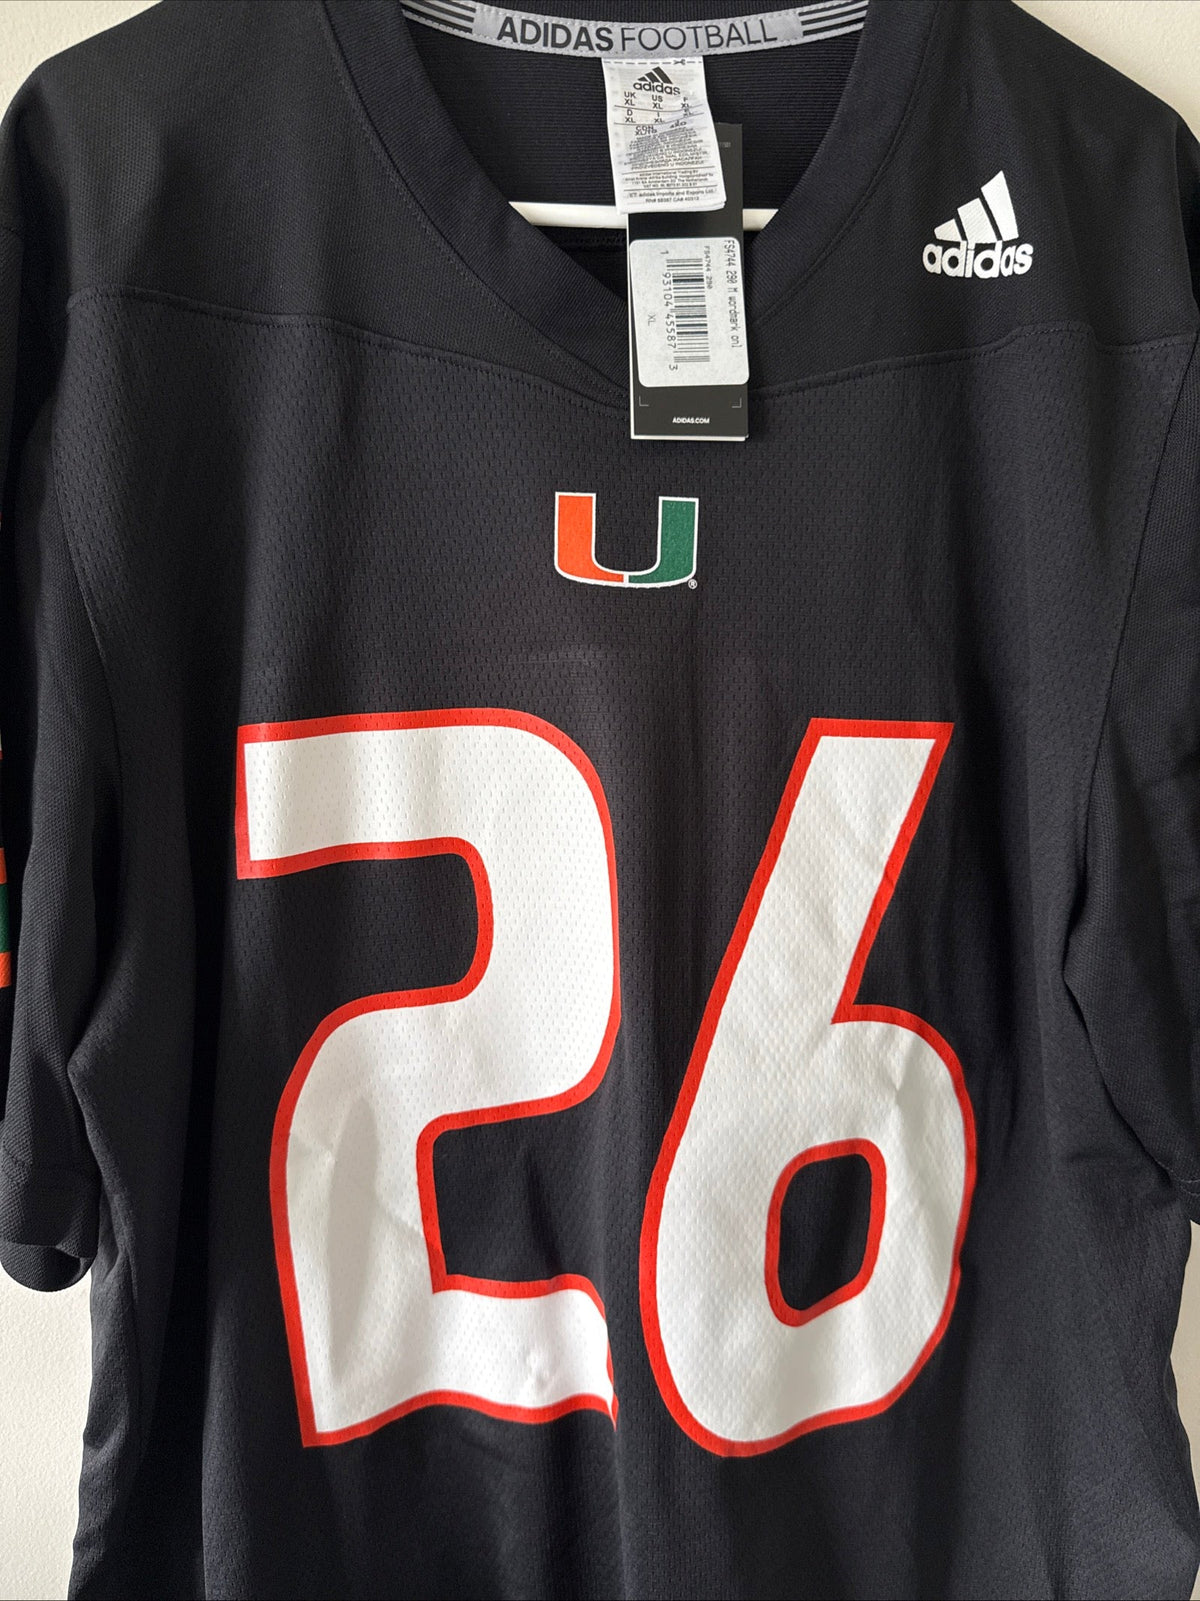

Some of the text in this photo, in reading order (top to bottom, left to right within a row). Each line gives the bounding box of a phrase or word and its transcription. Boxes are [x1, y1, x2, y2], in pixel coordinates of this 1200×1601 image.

[497, 16, 778, 51] ADIDAS FOOTBALL
[624, 91, 636, 99] UK
[652, 94, 663, 103] US
[624, 98, 635, 107] XL
[652, 102, 663, 110] XL
[633, 82, 681, 95] adidas
[724, 239, 736, 267] FS4744
[922, 240, 1034, 279] adidas
[662, 272, 673, 307] 93104
[647, 313, 656, 326] XL
[728, 296, 741, 331] wordmark
[665, 313, 677, 349] 45587
[669, 363, 678, 371] 3
[672, 416, 710, 424] ADIDAS.COM
[554, 491, 699, 588] U
[235, 707, 978, 1457] 26
